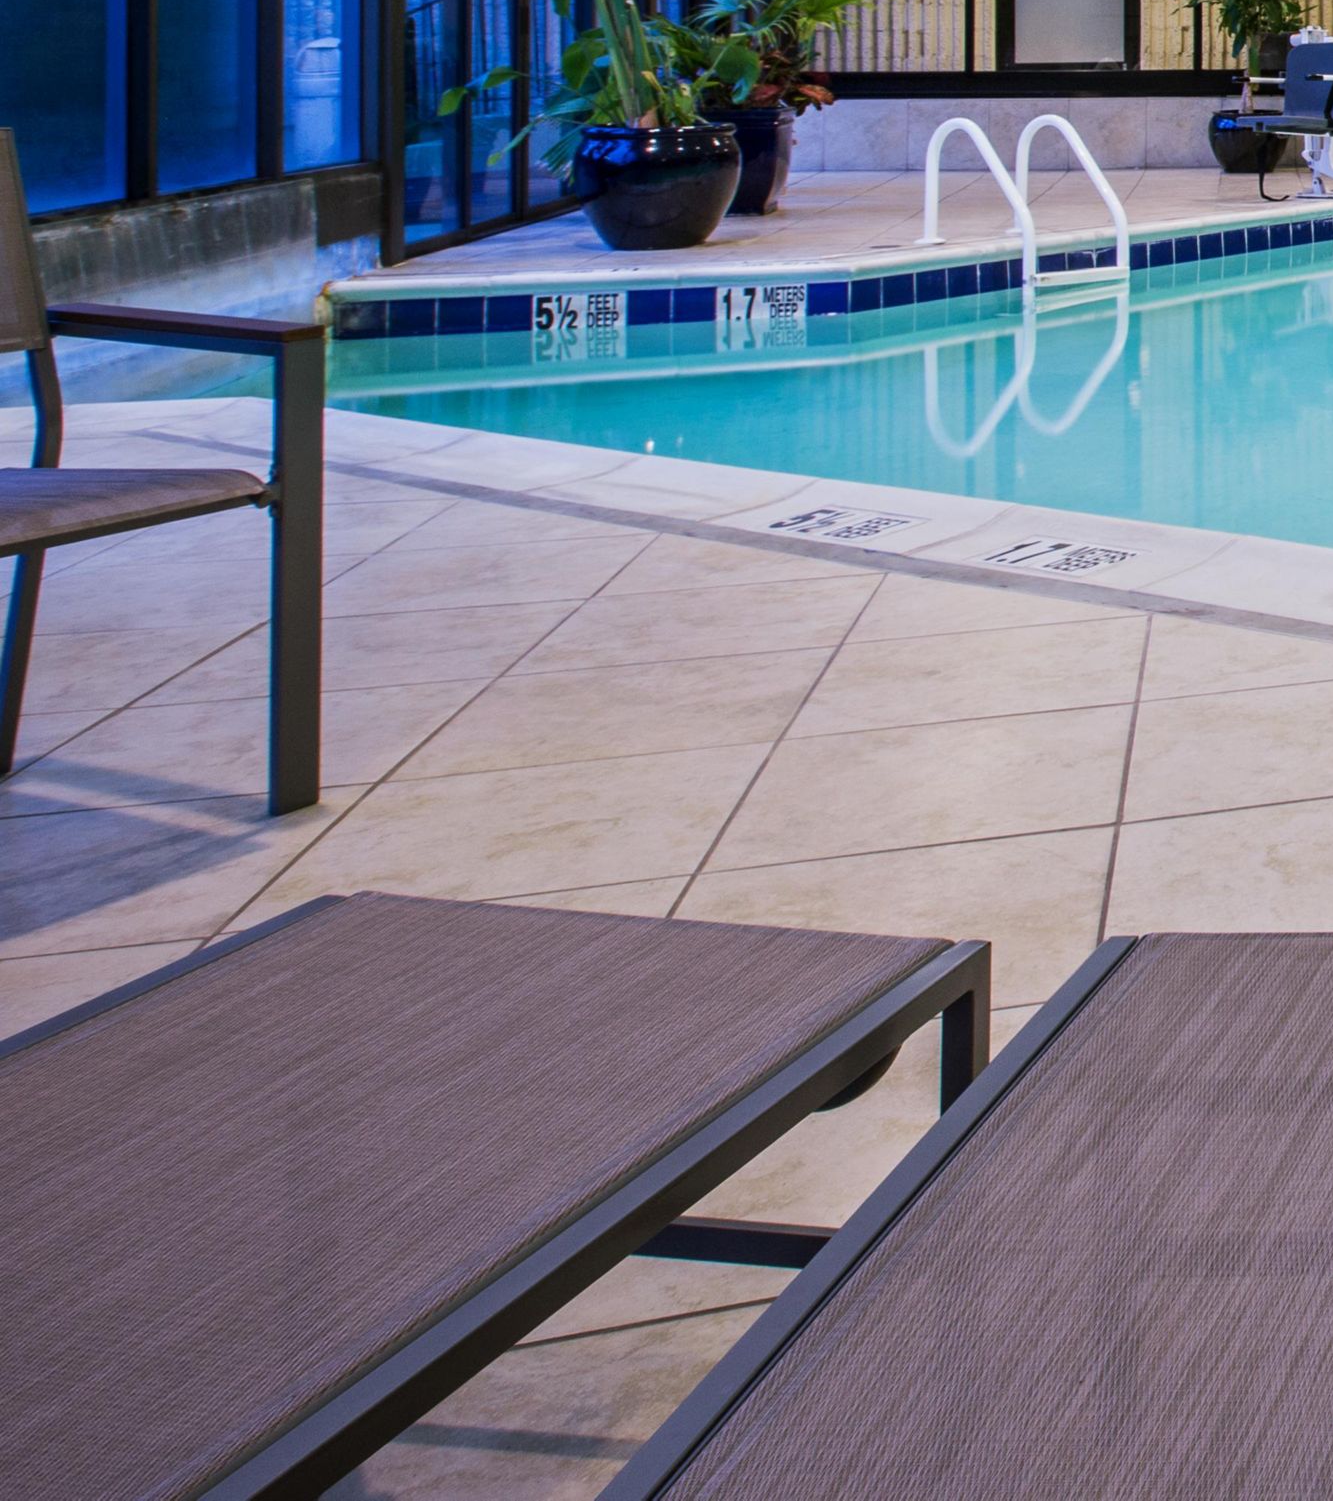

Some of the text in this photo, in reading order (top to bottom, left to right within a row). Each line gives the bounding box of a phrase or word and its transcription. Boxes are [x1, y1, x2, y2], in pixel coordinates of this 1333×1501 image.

[587, 293, 619, 311] FEET
[763, 286, 805, 304] METERS
[722, 287, 756, 322] 1.7
[769, 302, 799, 318] DEEP
[587, 310, 619, 328] DEEP
[984, 540, 1073, 564] 1.7
[1063, 546, 1137, 563] METERS
[1043, 556, 1100, 571] DEEP
